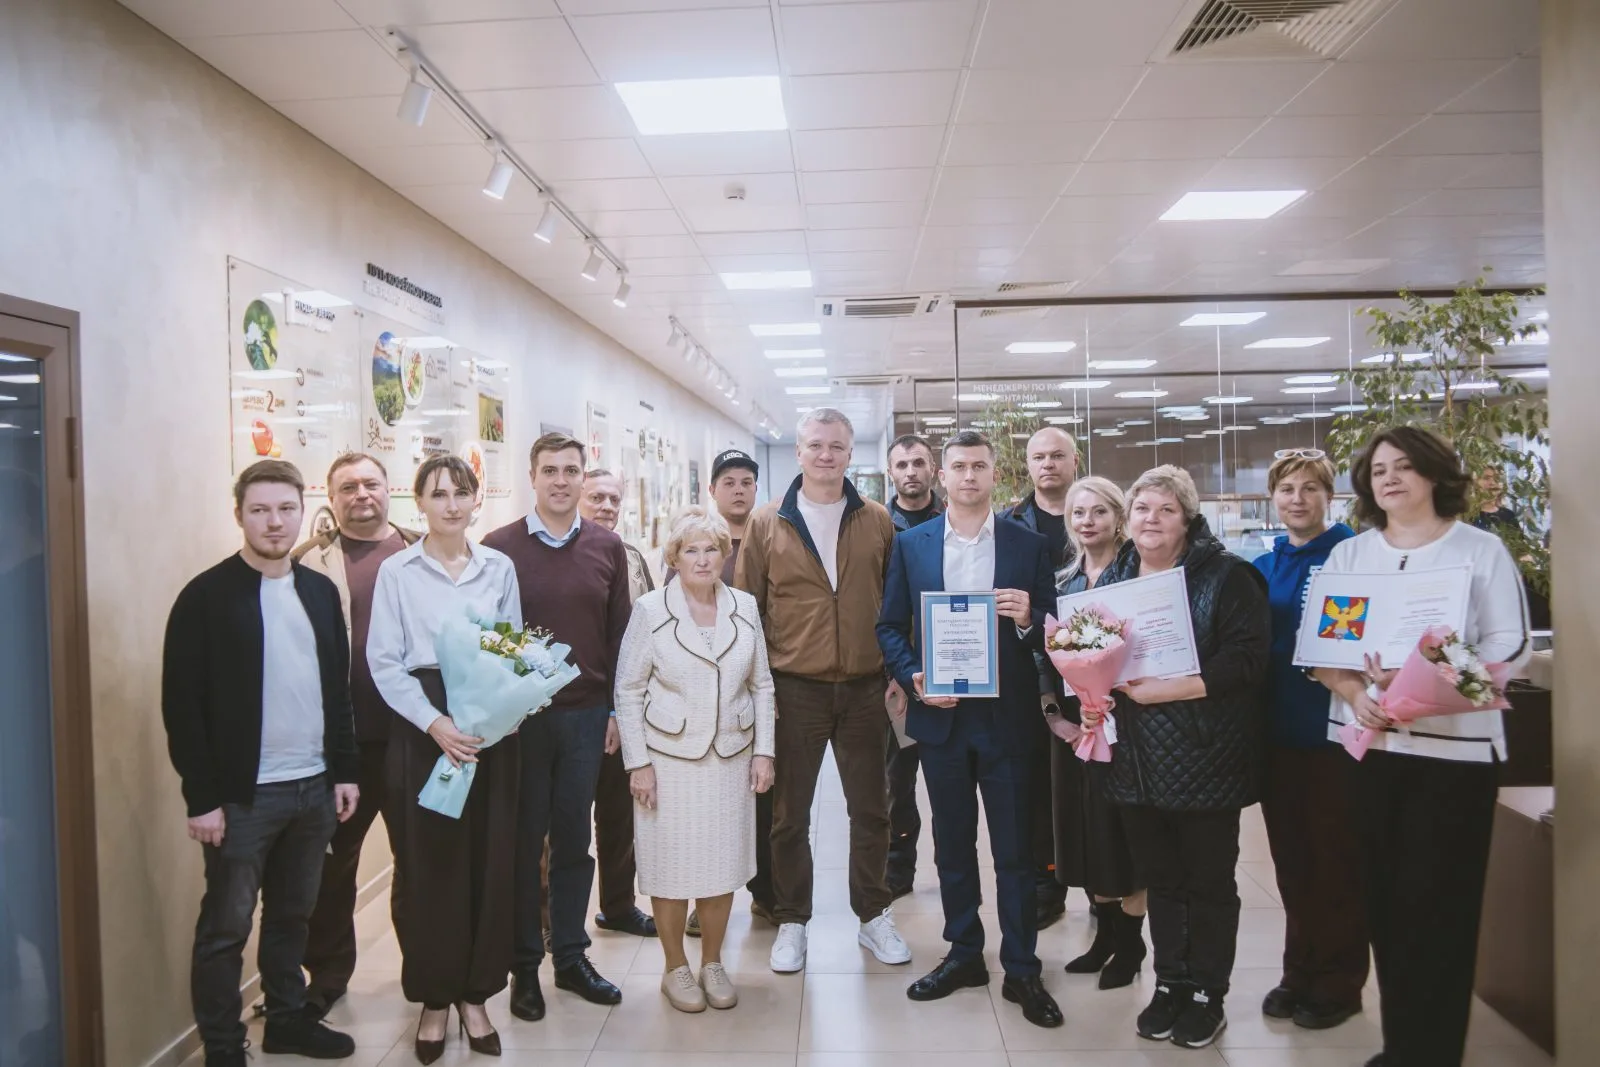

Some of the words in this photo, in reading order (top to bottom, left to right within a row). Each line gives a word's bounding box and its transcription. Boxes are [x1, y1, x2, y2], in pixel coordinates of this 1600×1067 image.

[973, 383, 1030, 392] МЕНЕДЖЕРЫ
[1032, 383, 1046, 391] ПО
[266, 390, 275, 412] 2
